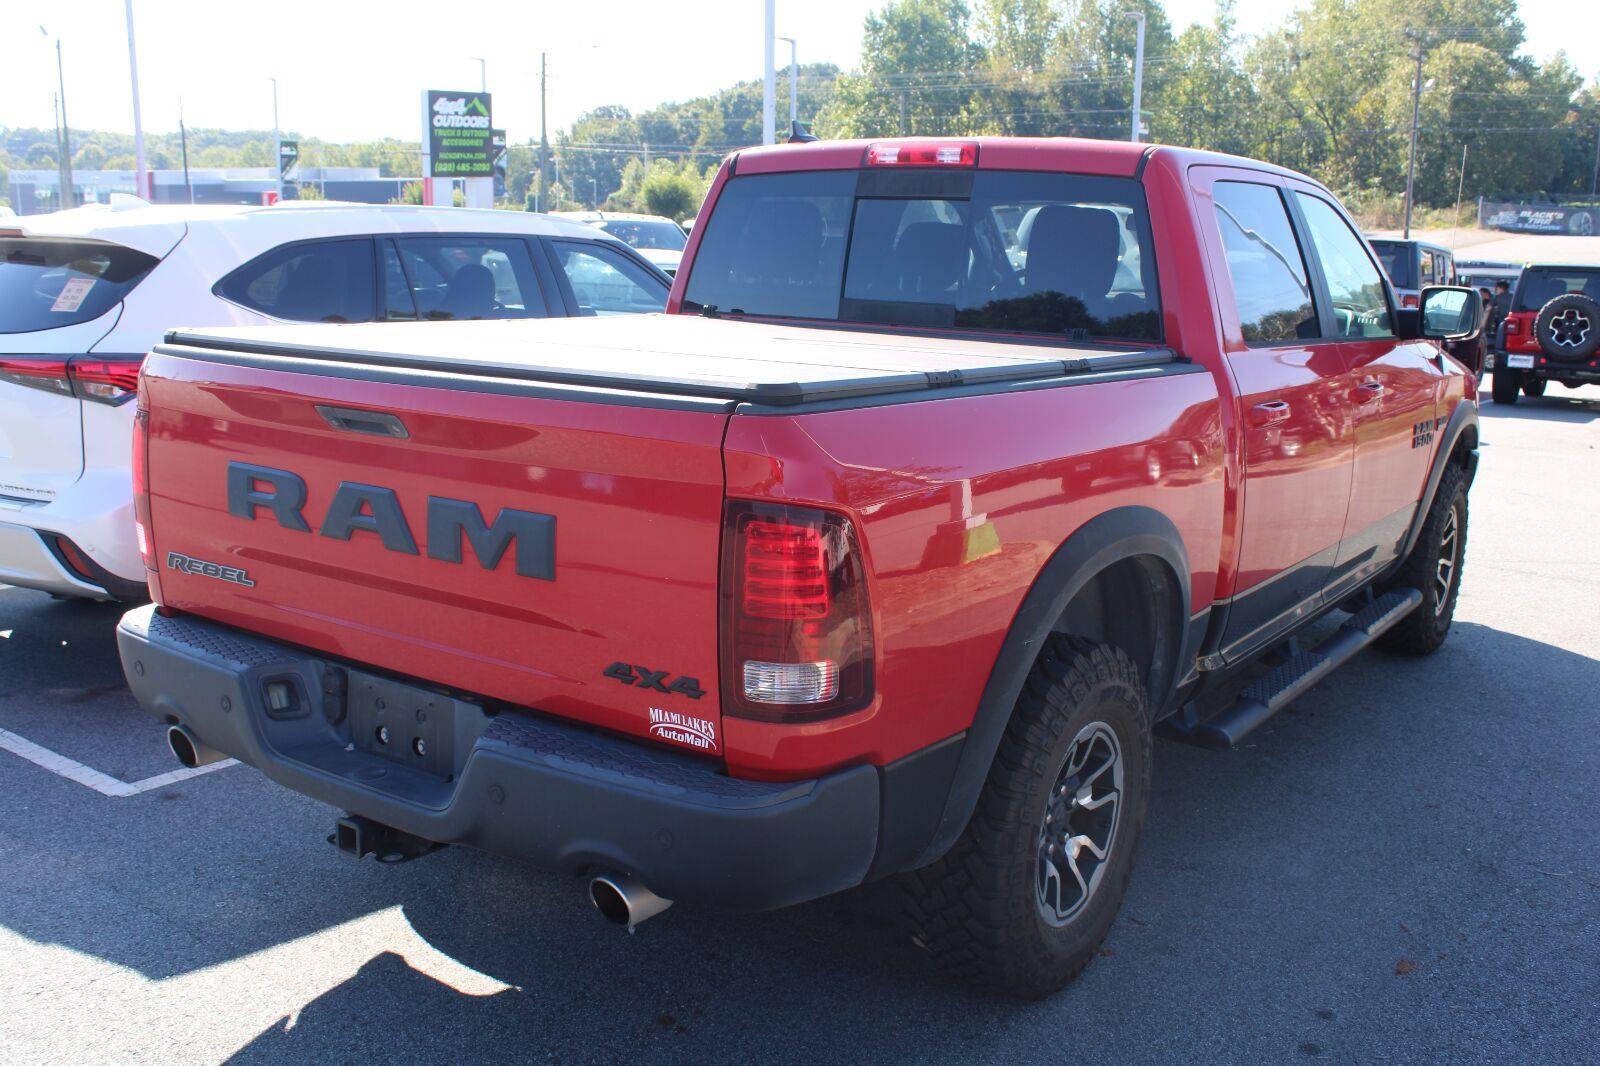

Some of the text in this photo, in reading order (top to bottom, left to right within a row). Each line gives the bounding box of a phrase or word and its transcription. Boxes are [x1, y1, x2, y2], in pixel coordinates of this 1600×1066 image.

[433, 115, 490, 128] OUTDOORS
[227, 460, 557, 582] RAM
[167, 551, 256, 588] REBEL
[603, 662, 707, 700] 4X4
[649, 707, 715, 739] MIAMI LAKES
[657, 727, 709, 749] AutoMall
